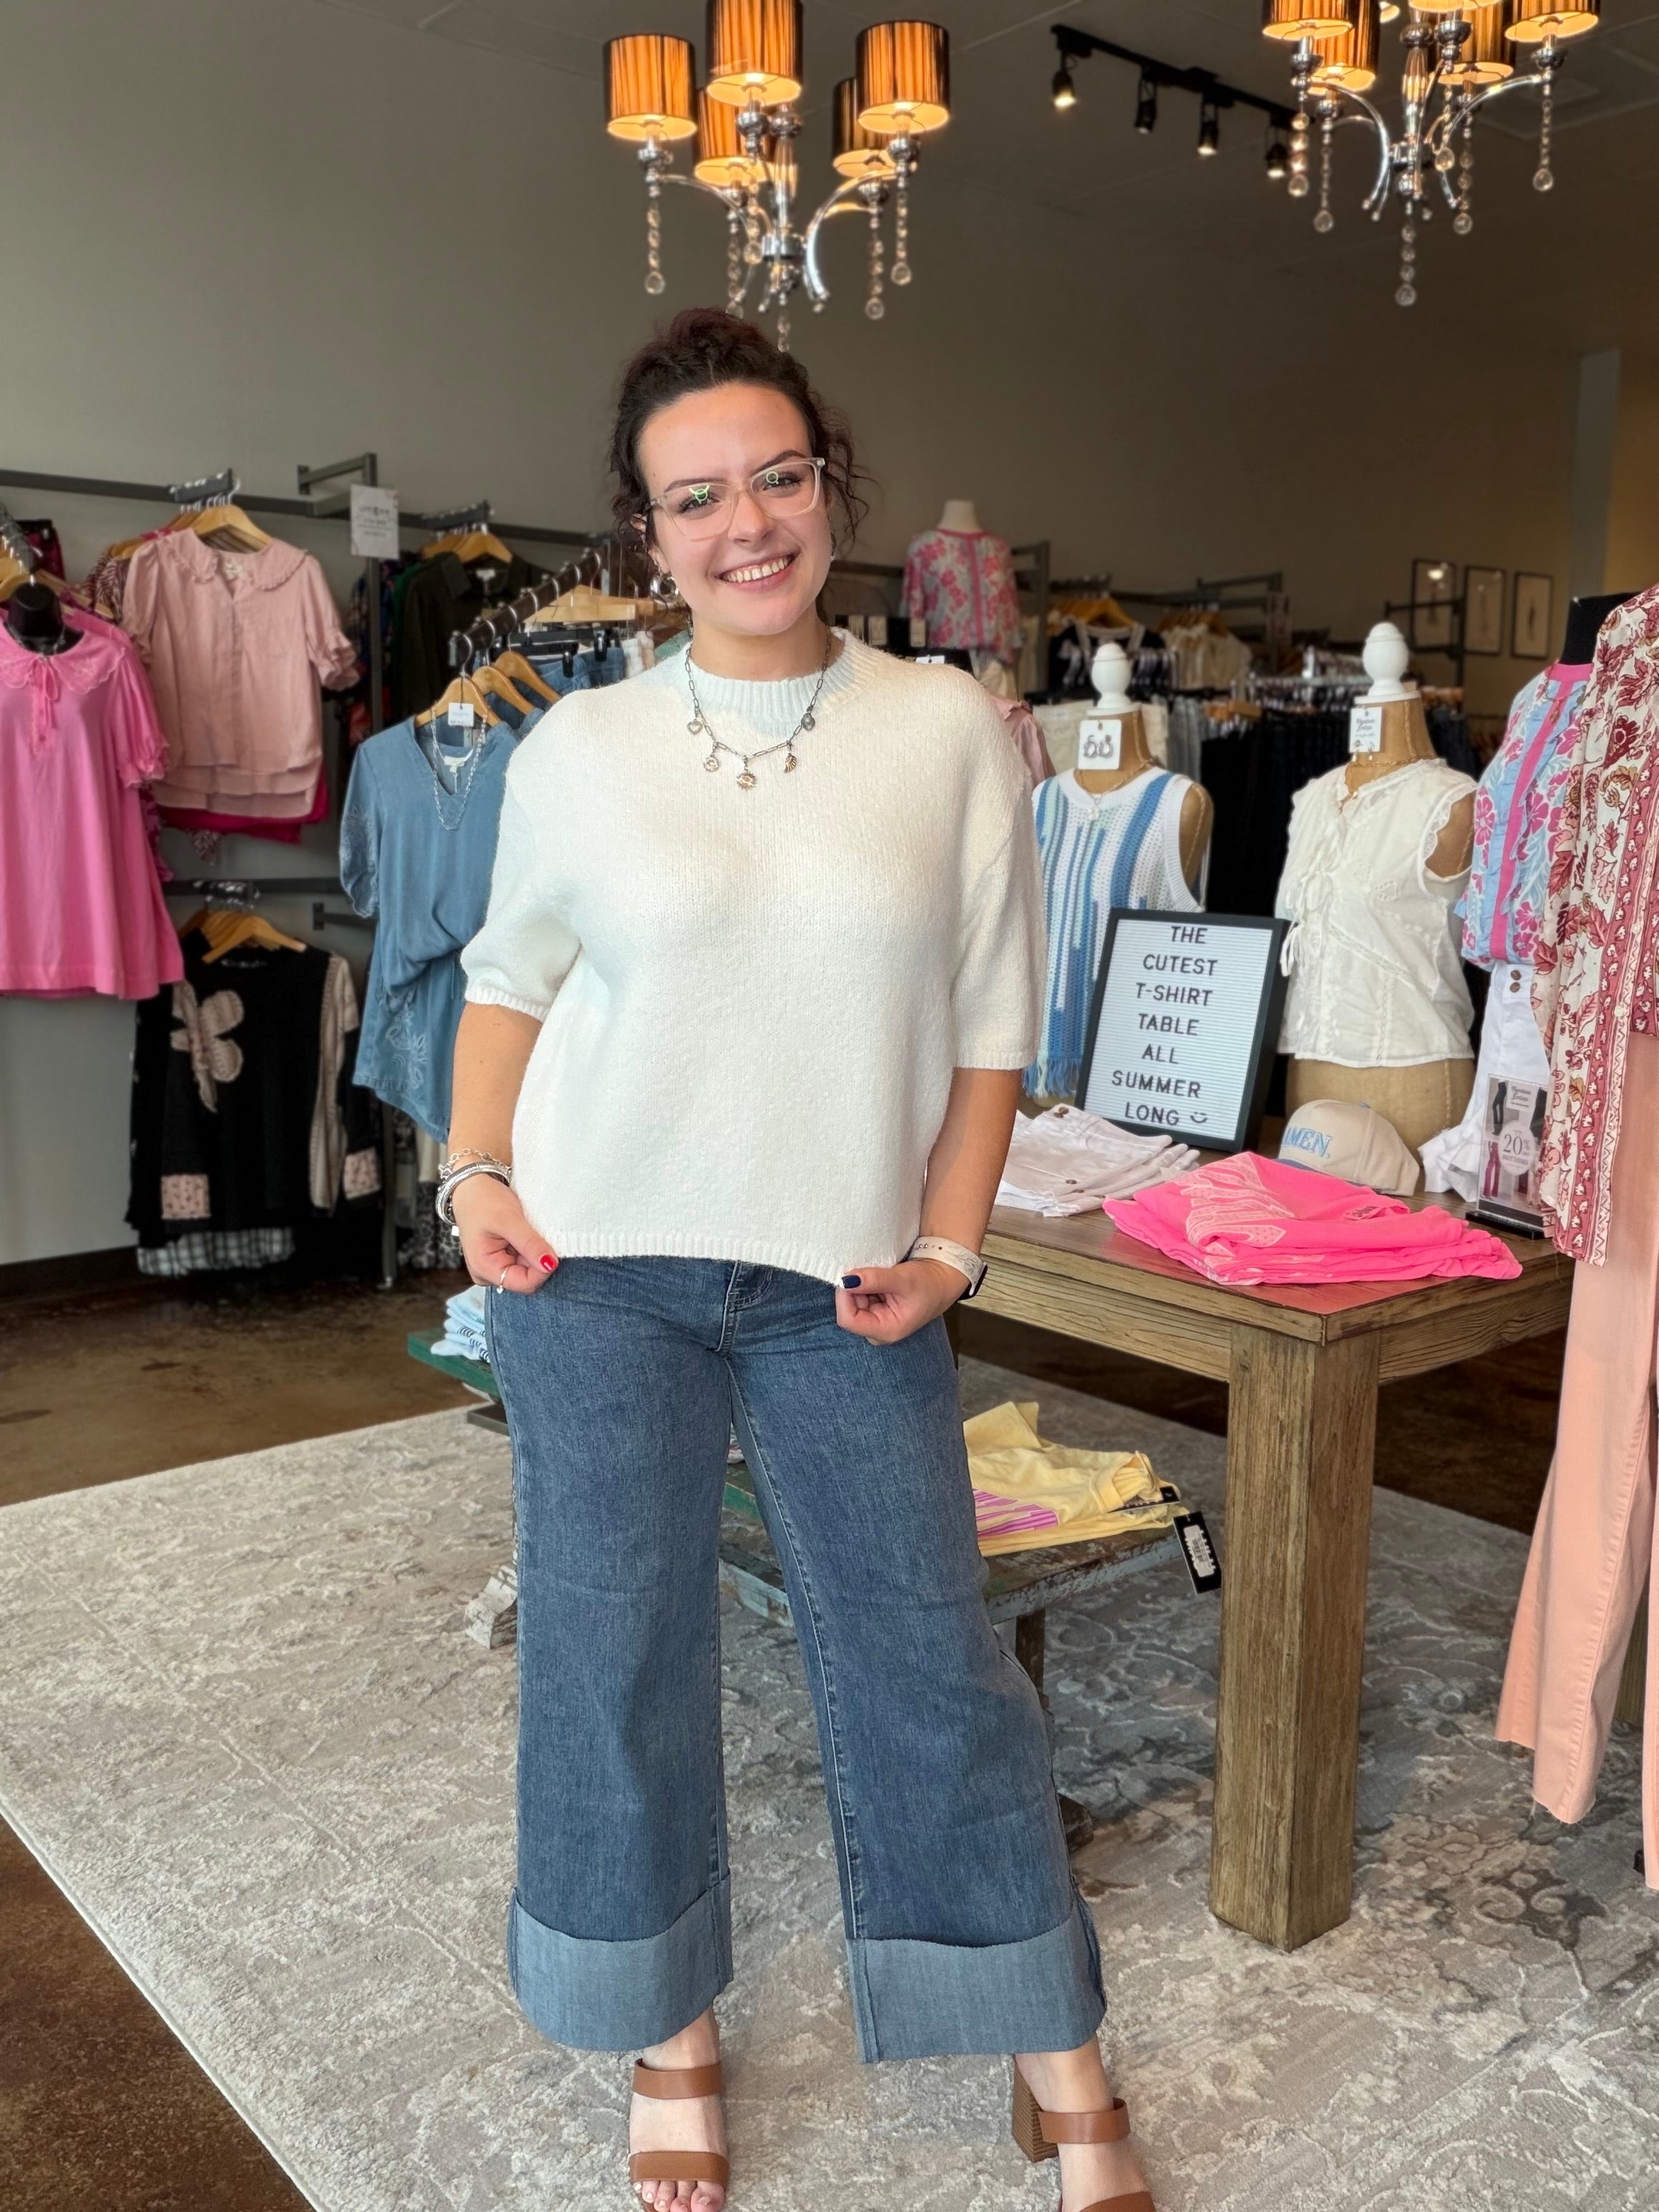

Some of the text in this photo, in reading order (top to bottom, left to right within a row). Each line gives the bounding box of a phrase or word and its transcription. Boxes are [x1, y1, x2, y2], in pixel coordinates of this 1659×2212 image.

[1171, 925, 1208, 945] THE
[1143, 953, 1218, 976] CUTEST
[1136, 982, 1213, 1006] T-SHIRT
[1138, 1013, 1199, 1037] TABLE
[1141, 1044, 1179, 1064] ALL
[1111, 1070, 1201, 1098] SUMMER
[1124, 1102, 1179, 1126] LONG
